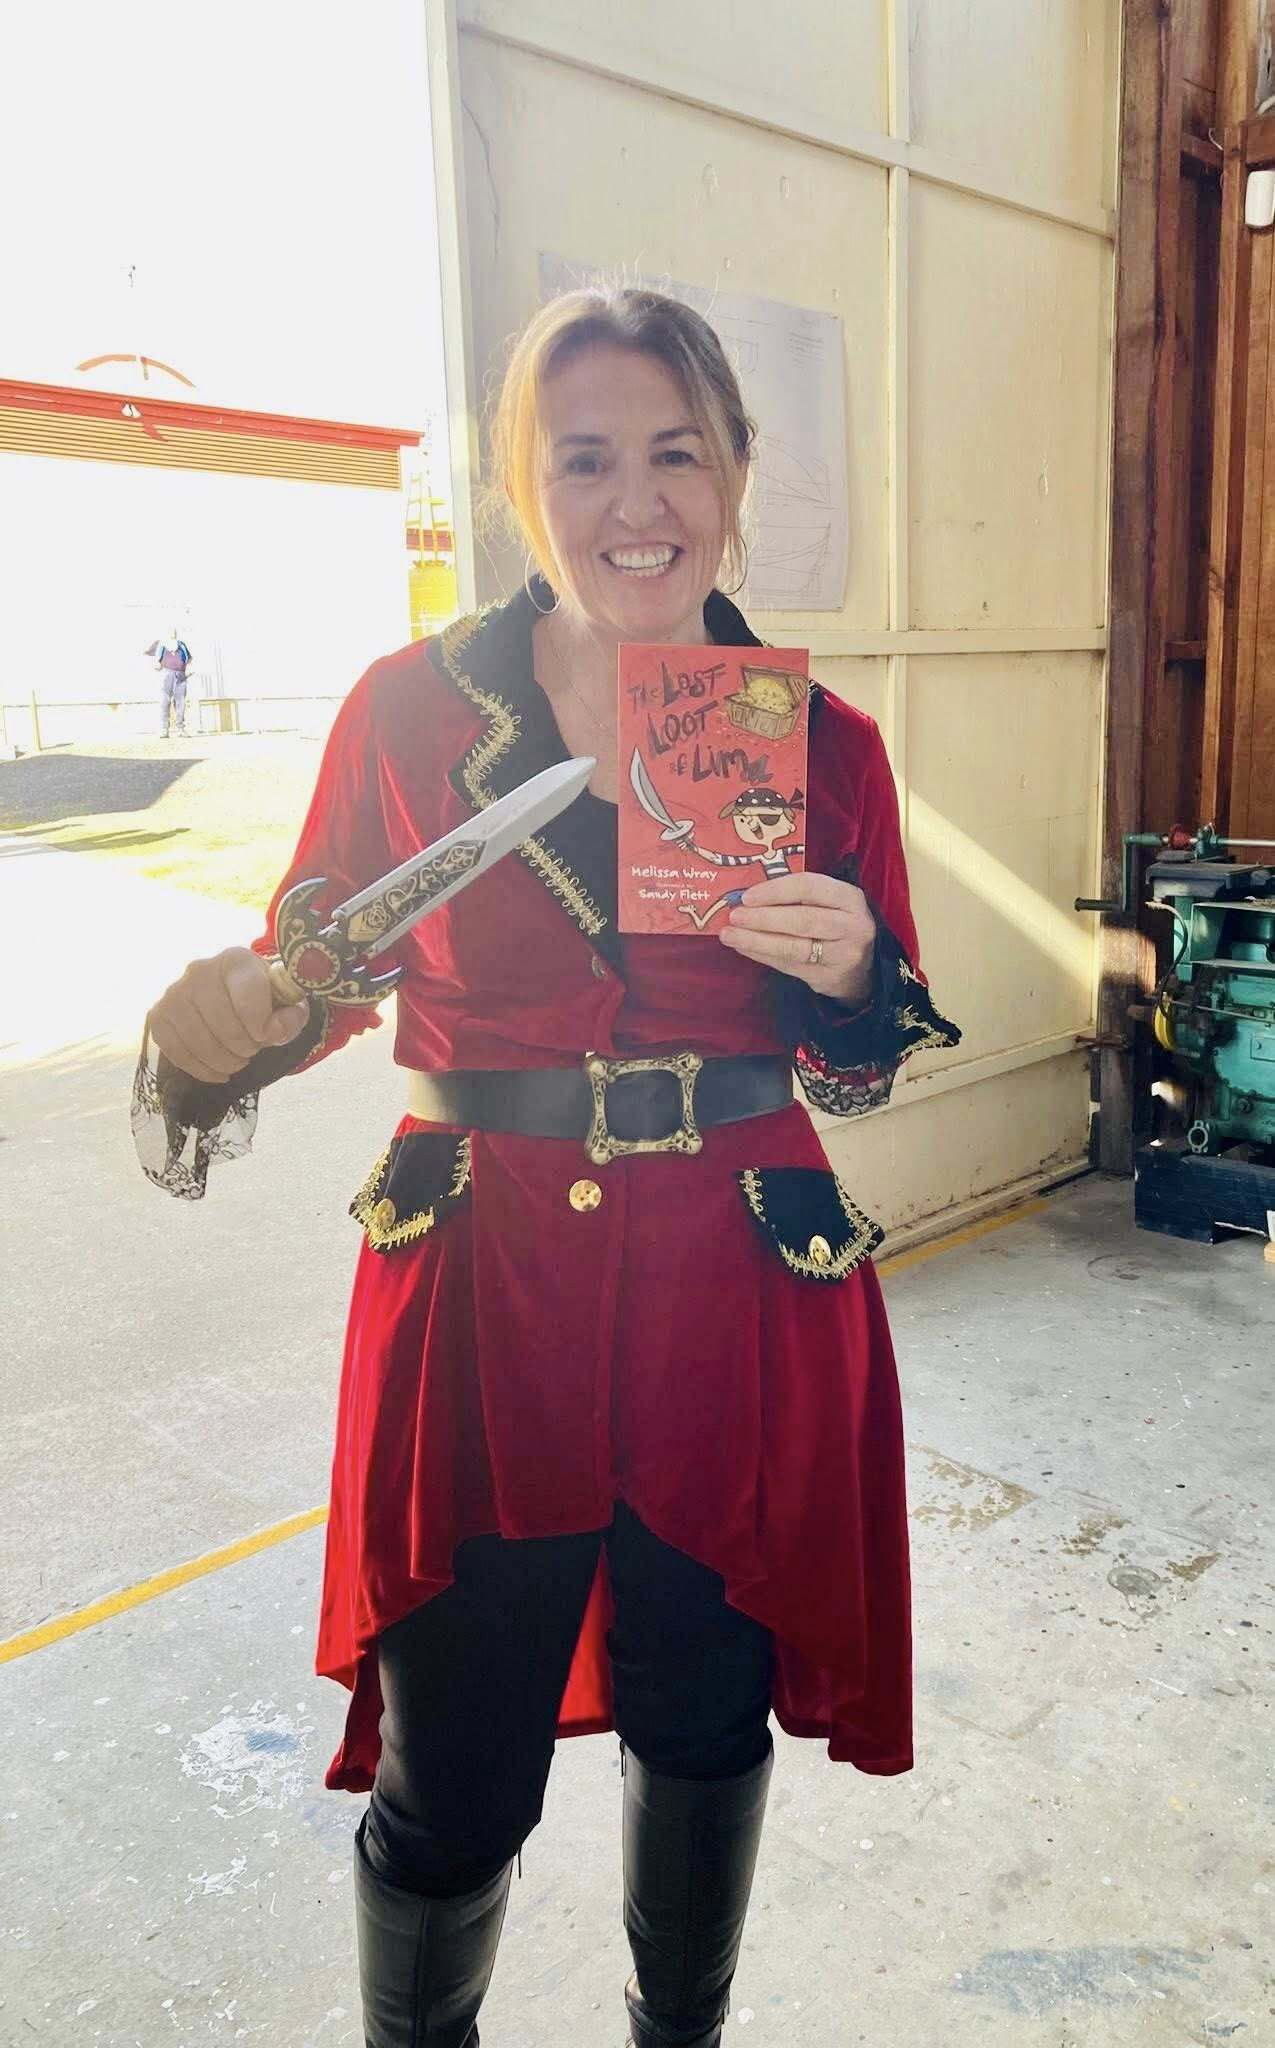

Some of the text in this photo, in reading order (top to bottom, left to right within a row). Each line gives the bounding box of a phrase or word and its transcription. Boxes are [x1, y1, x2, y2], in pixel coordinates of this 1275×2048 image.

[646, 700, 719, 756] LOOT
[631, 865, 719, 882] Melissa Wray
[638, 888, 711, 902] Sandy Flett
